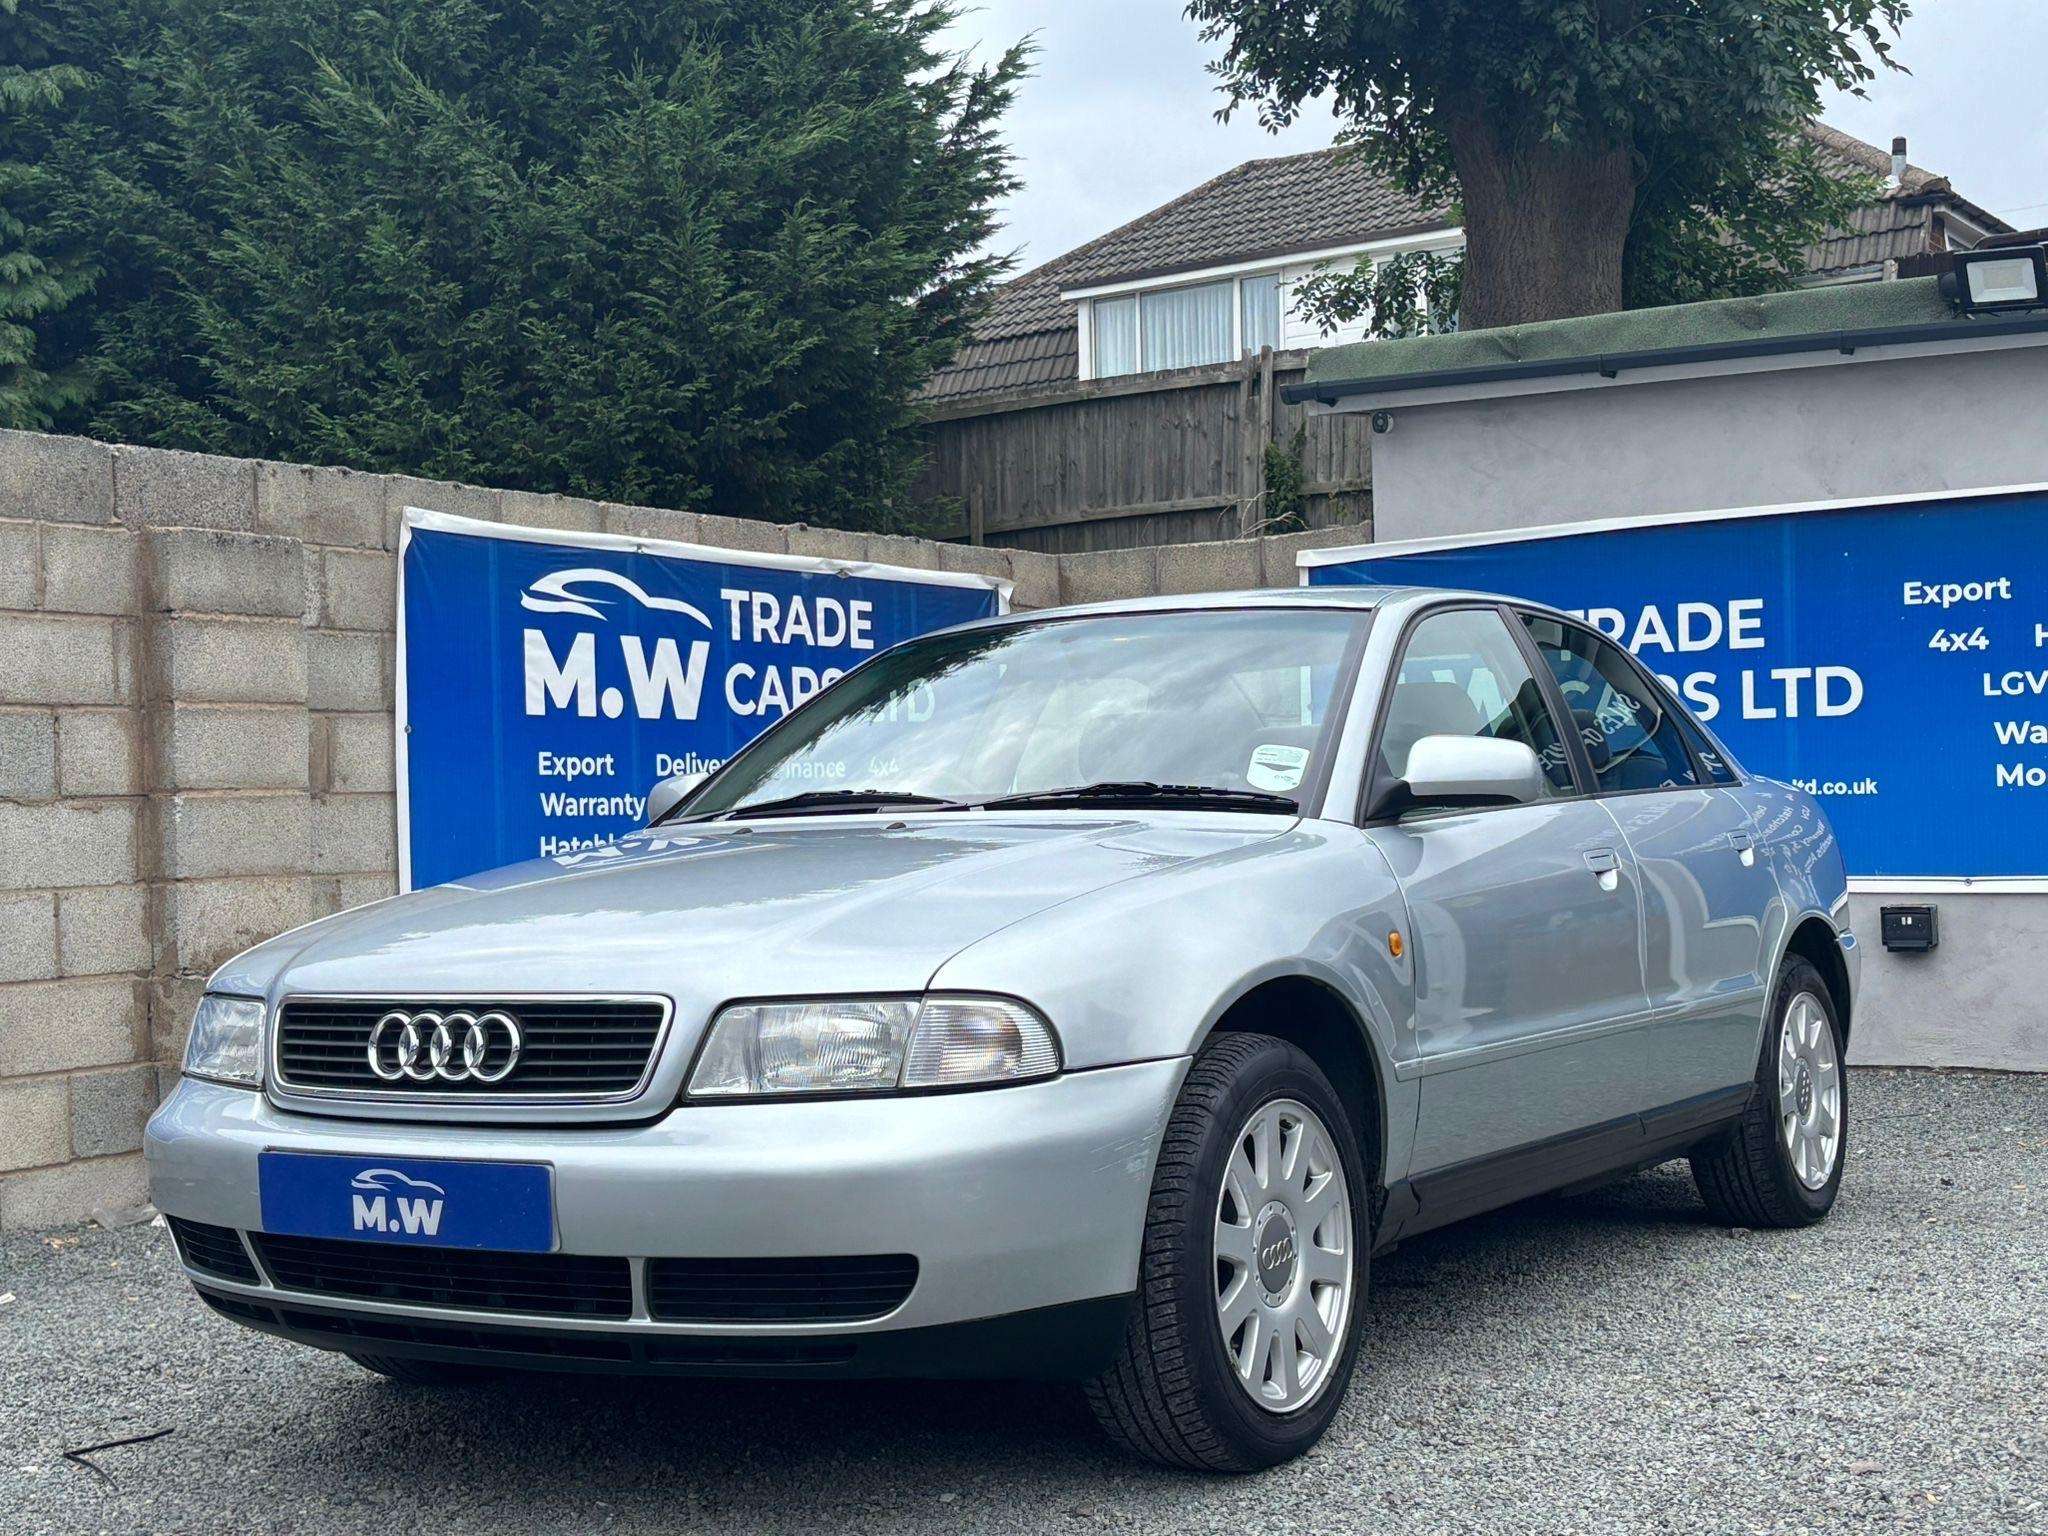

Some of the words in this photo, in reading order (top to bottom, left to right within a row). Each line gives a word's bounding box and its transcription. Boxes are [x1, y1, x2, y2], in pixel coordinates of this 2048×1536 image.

[1903, 577, 2012, 608] Export
[720, 588, 874, 649] TRADE
[1928, 627, 1990, 652] 4x4
[523, 628, 710, 720] M.W
[1983, 670, 2048, 696] LGV
[1742, 666, 1863, 719] LTD
[538, 751, 615, 781] Export
[1996, 763, 2048, 787] Mo
[540, 792, 646, 821] Warranty
[352, 1195, 443, 1236] M.W
